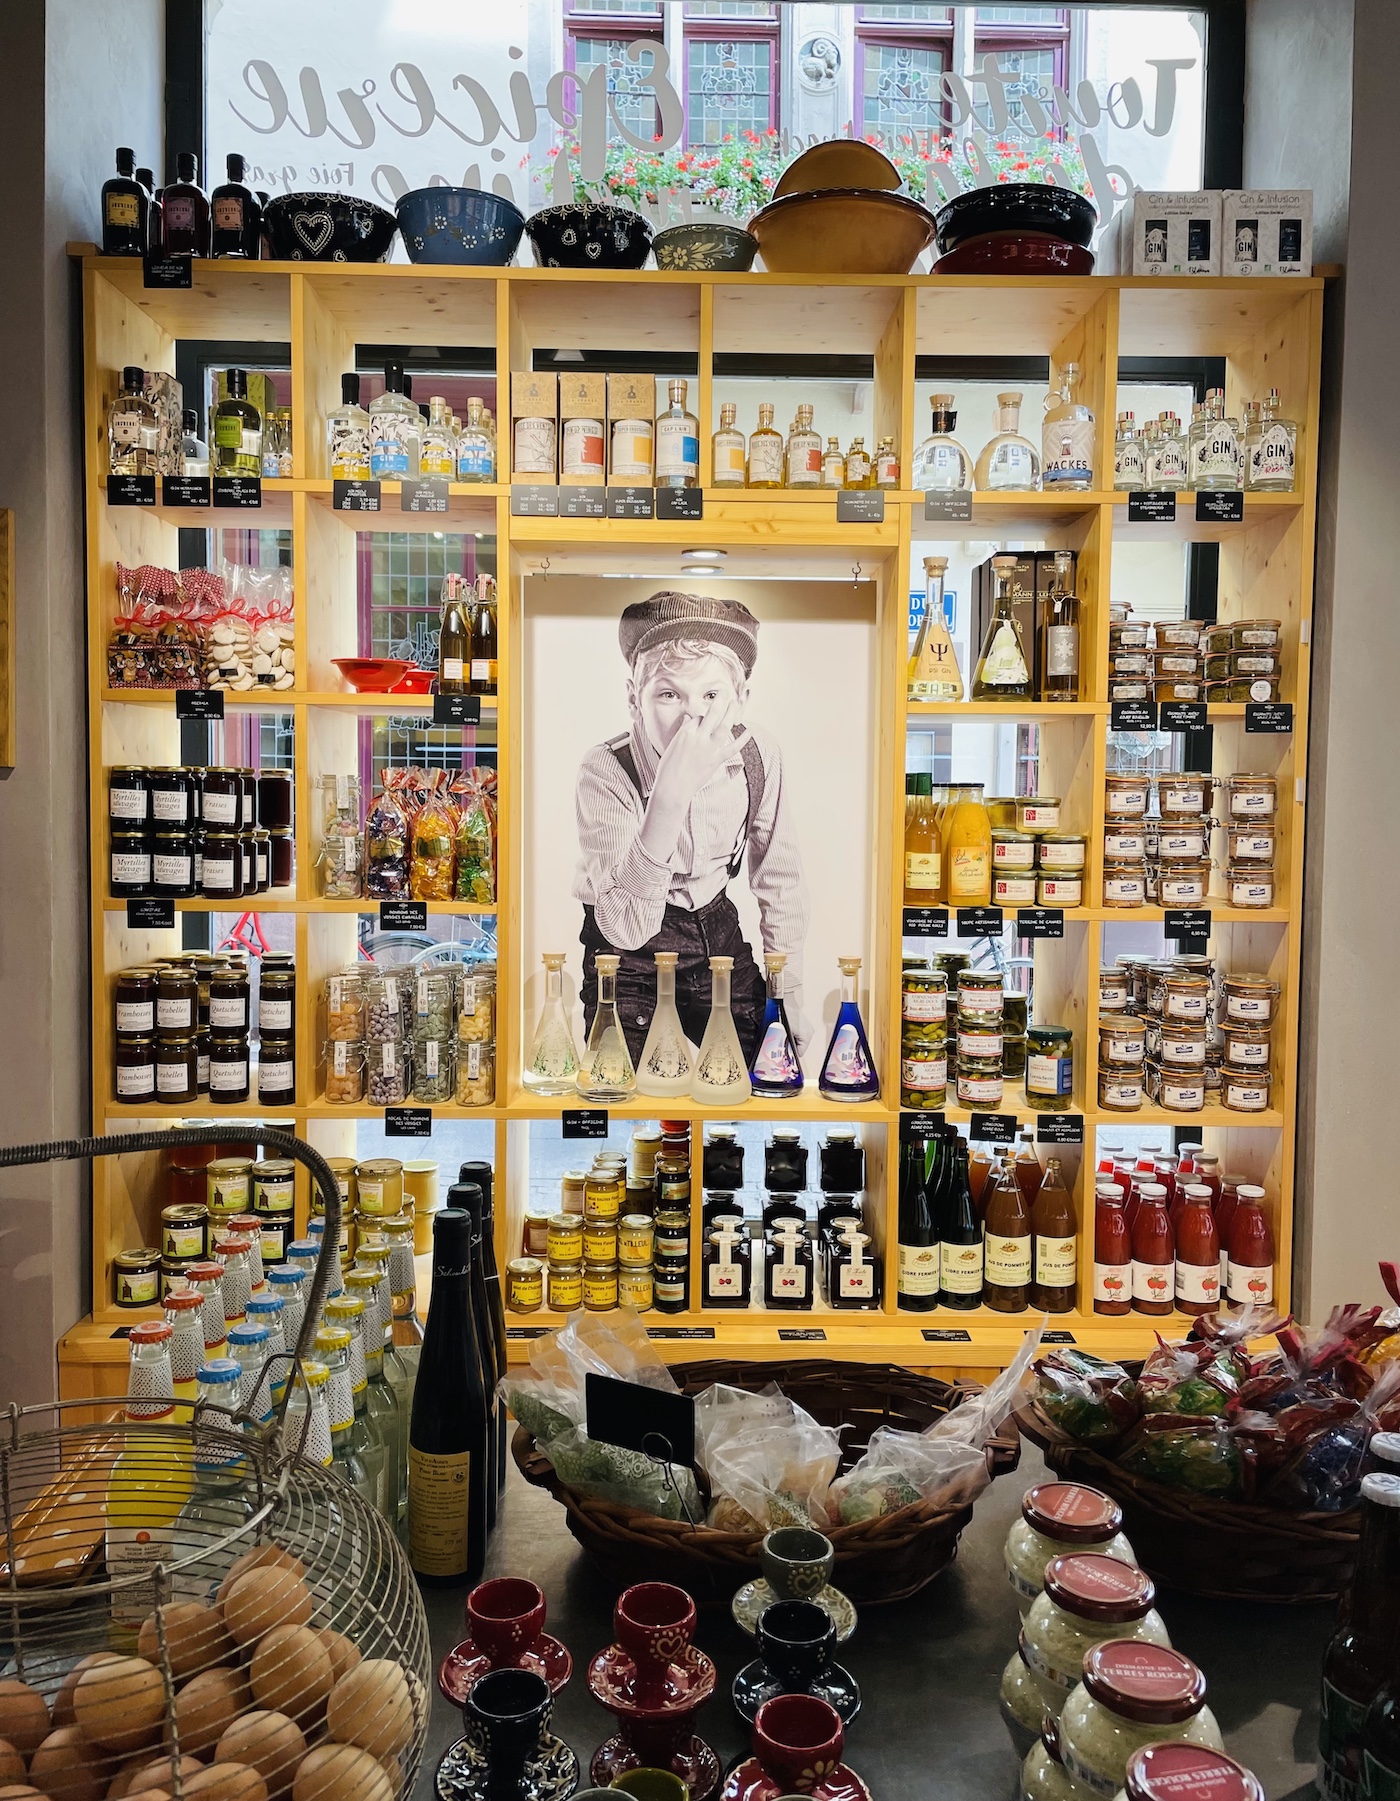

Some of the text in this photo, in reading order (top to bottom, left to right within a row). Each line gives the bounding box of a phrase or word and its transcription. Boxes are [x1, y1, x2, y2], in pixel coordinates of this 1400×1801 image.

[1149, 195, 1164, 204] Gin
[1176, 195, 1209, 204] Infusion
[1239, 194, 1255, 204] Gin
[1267, 194, 1300, 204] Infusion
[1148, 243, 1162, 254] GIN
[1238, 242, 1253, 252] GIN
[1212, 441, 1231, 454] GIN
[1266, 444, 1286, 458] GIN
[1124, 457, 1138, 467] GIN
[1165, 454, 1179, 464] GIN
[343, 465, 358, 473] GIN
[1046, 460, 1088, 471] WACKES
[631, 1283, 652, 1292] TILLEUL
[1053, 1486, 1080, 1520] TERRES ROUGES
[1068, 1557, 1136, 1593] TERRES ROUGES
[1115, 1663, 1155, 1671] DOMAINE
[1102, 1667, 1190, 1679] TERRES ROUGES
[1146, 1765, 1236, 1787] TERRES ROUGES
